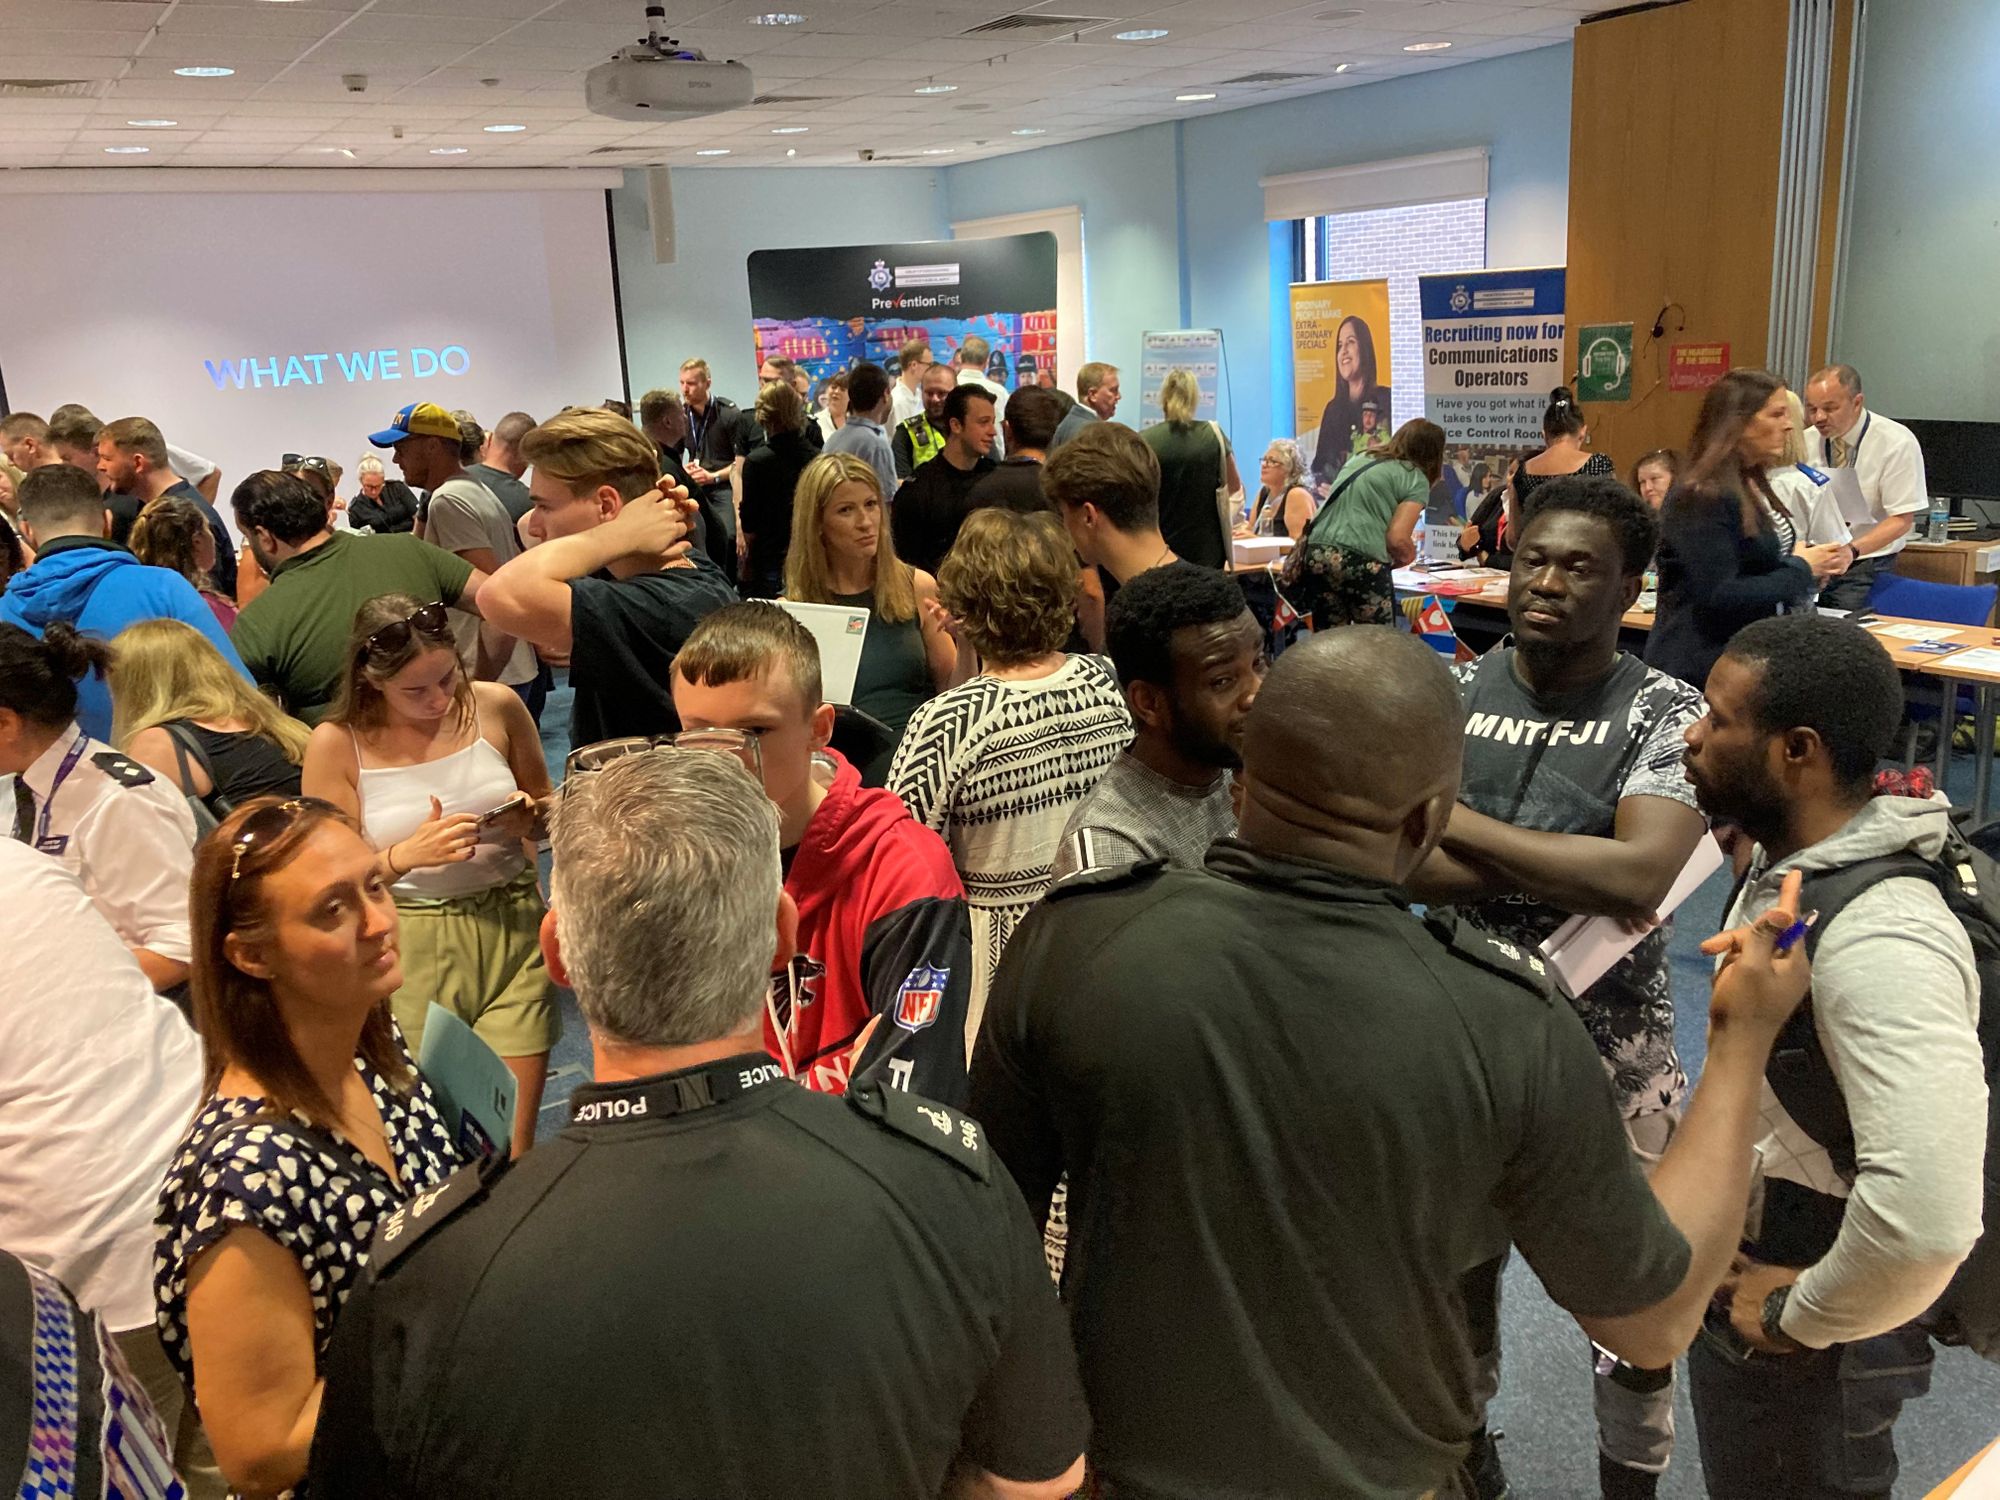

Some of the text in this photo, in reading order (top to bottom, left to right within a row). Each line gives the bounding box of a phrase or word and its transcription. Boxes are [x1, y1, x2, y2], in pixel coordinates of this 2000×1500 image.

[1295, 330, 1333, 339] ORDINARY
[1425, 322, 1565, 343] Recruiting now for
[1295, 339, 1328, 349] SPECIALS
[1429, 346, 1558, 365] Communications
[204, 345, 471, 391] WHAT WE DO
[1455, 369, 1529, 388] Operators
[1436, 399, 1546, 412] Have you got what it
[1443, 414, 1537, 424] takes to work in a
[1467, 428, 1510, 439] Control
[1432, 529, 1448, 538] This
[573, 1096, 648, 1122] POLICE
